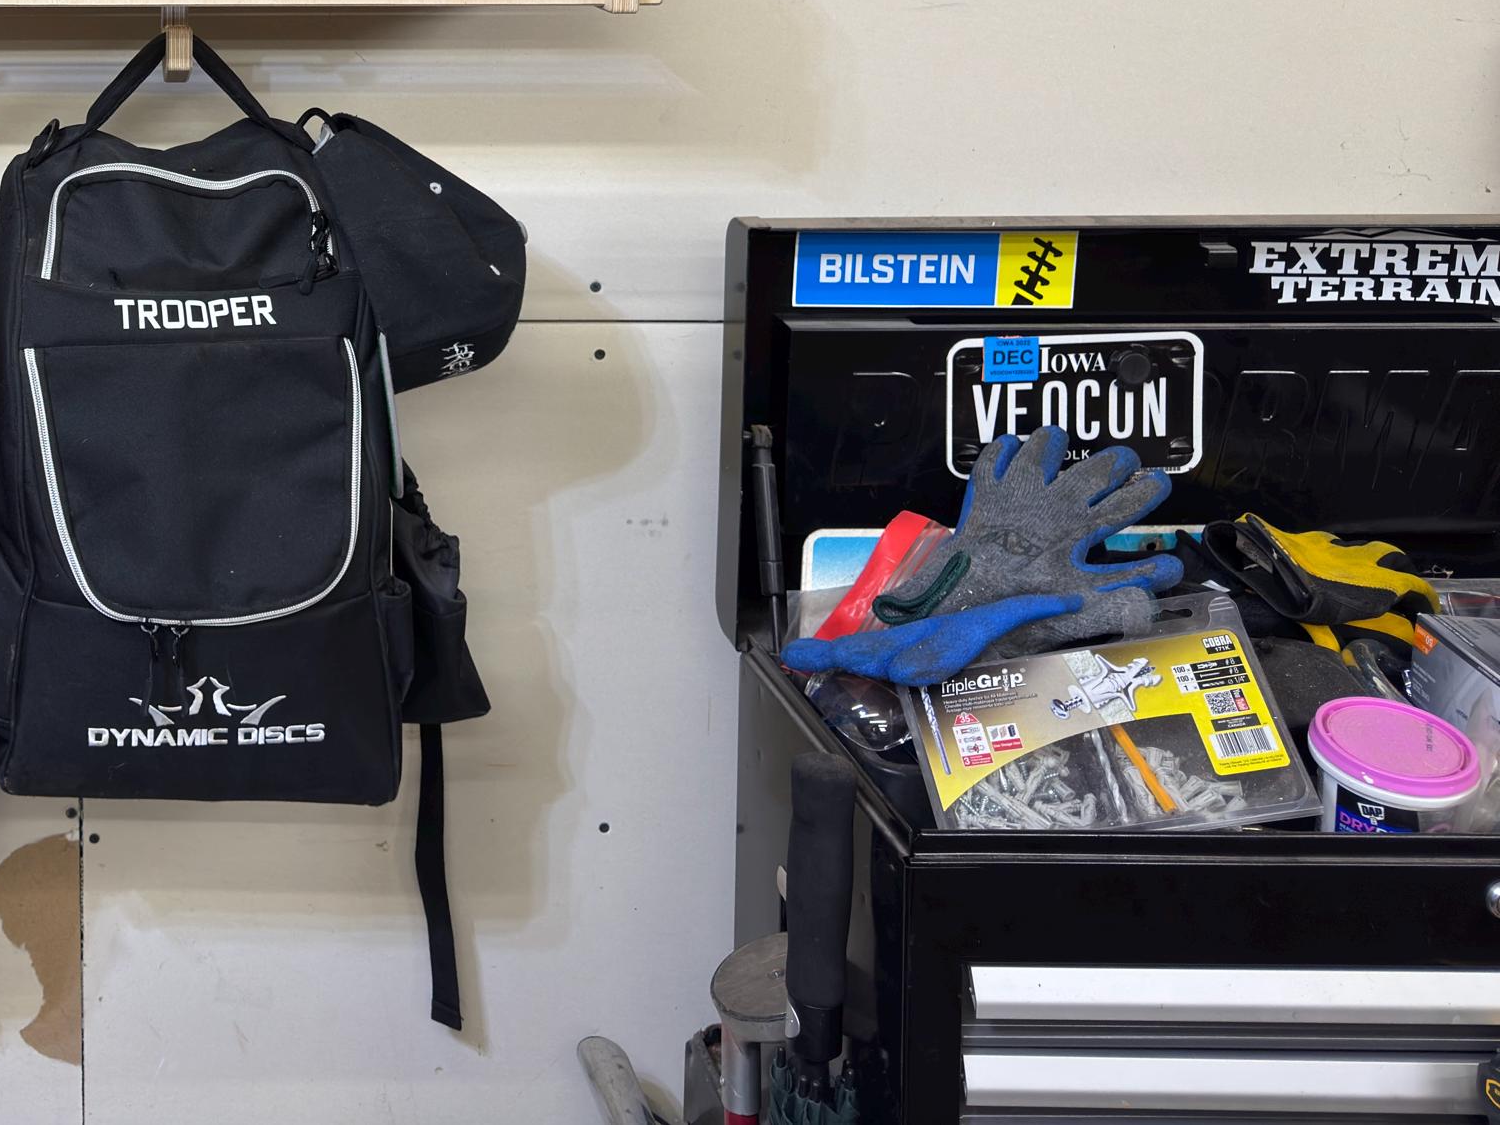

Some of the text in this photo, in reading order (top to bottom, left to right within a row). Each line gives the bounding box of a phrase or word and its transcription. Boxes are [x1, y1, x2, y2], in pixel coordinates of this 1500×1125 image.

[819, 253, 975, 284] BILSTEIN
[114, 295, 277, 330] TROOPER
[993, 350, 1033, 365] DEC
[1063, 449, 1090, 460] OLK
[1202, 635, 1232, 648] COBRA
[88, 723, 325, 747] DYNAMIC DISCS
[1361, 805, 1382, 816] DAP
